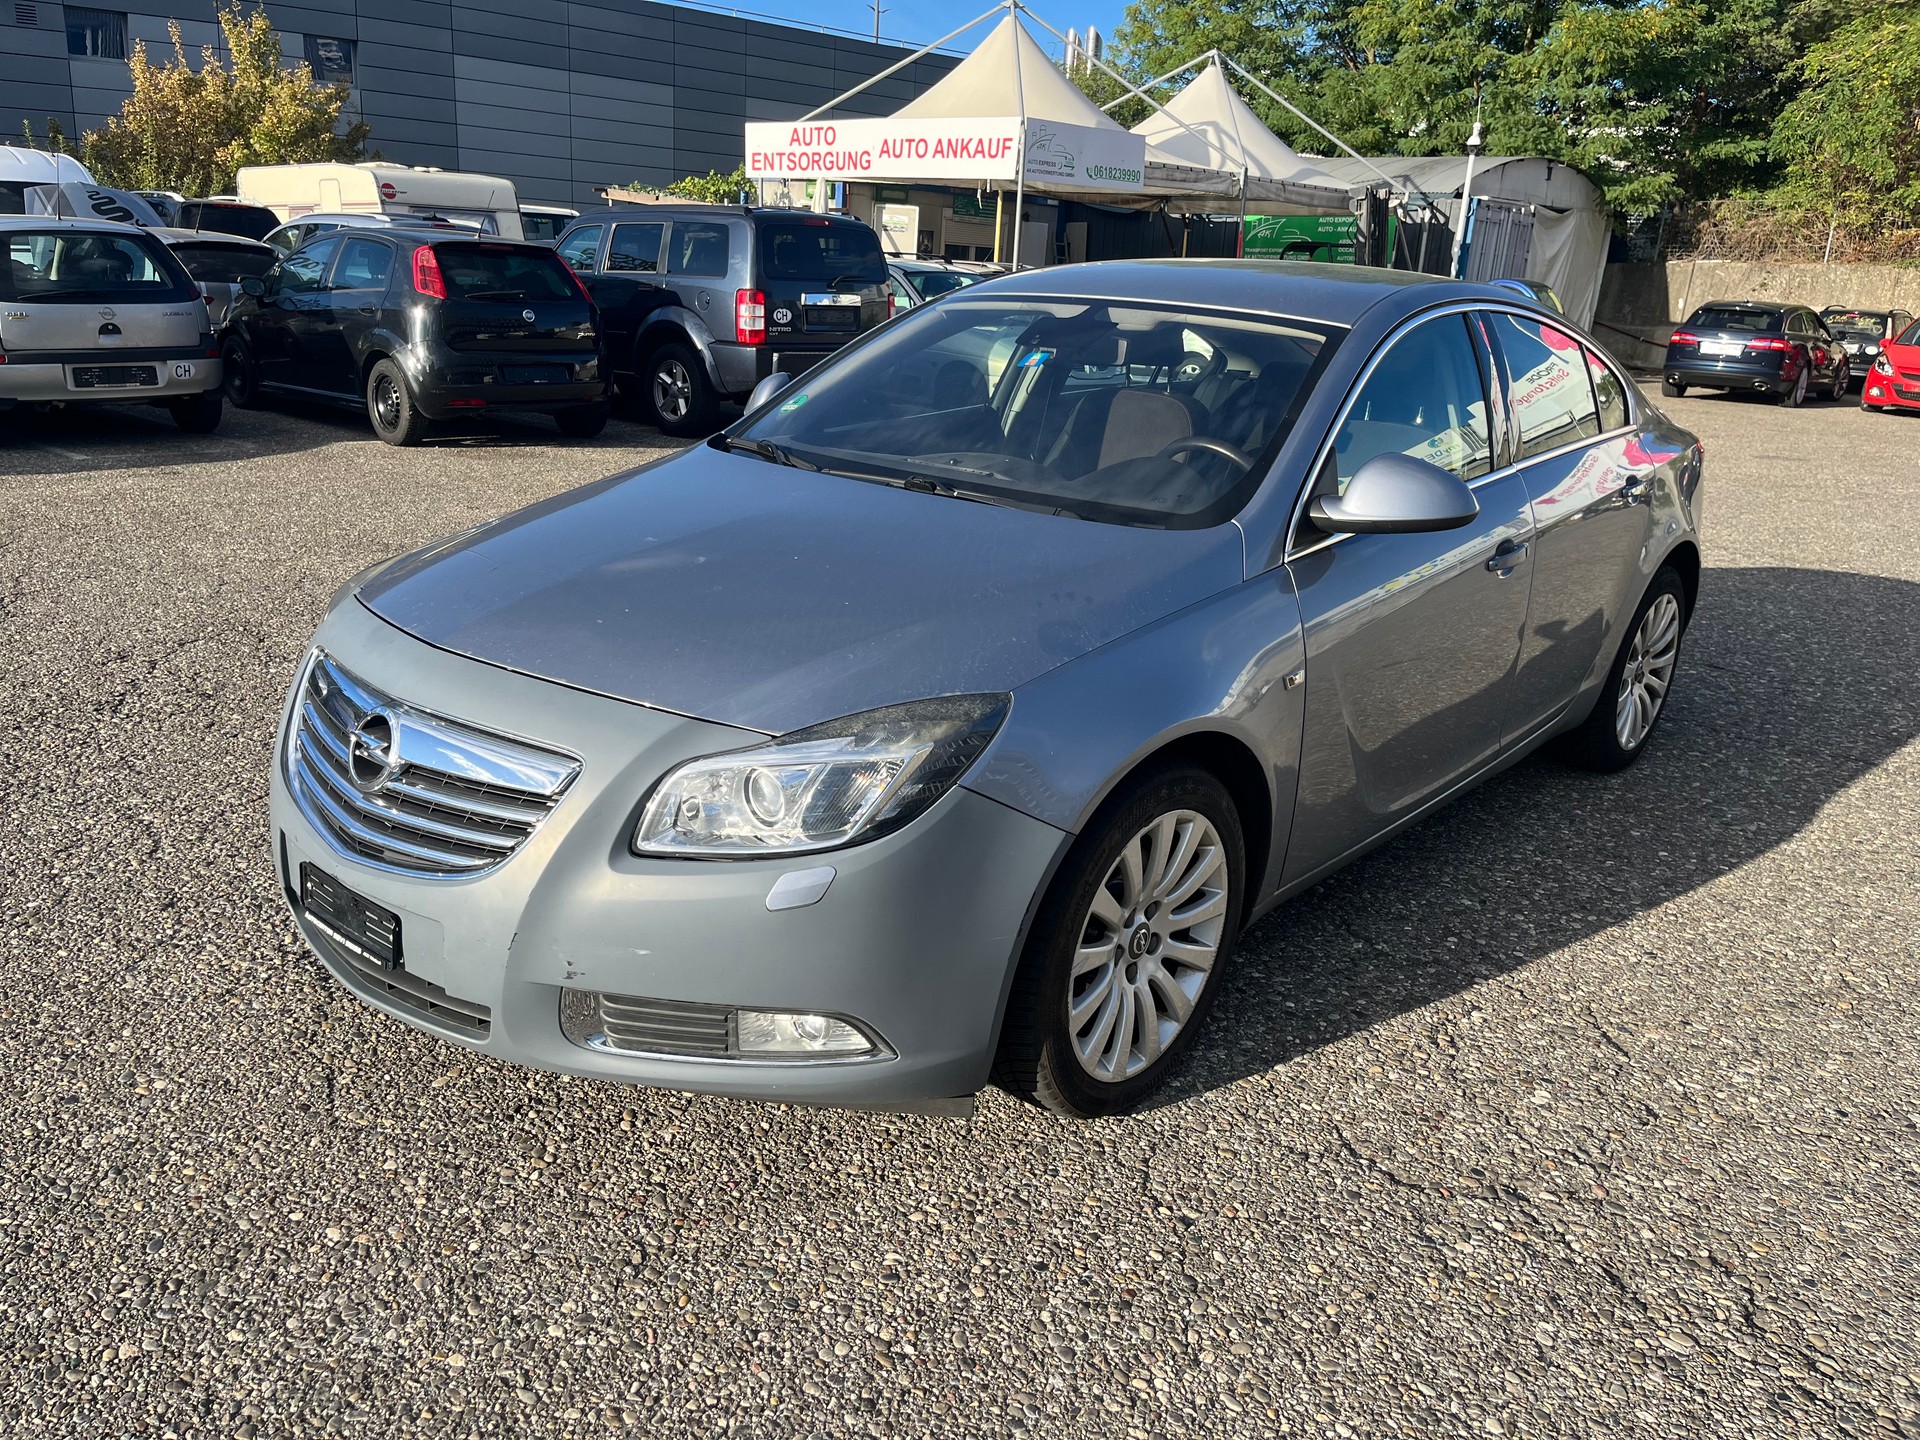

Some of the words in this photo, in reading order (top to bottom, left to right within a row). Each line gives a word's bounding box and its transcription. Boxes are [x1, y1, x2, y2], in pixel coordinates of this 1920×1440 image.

[789, 126, 836, 147] AUTO
[878, 138, 929, 159] AUTO
[932, 137, 1014, 160] ANKAUF
[751, 150, 872, 172] ENTSORGUNG
[1038, 159, 1057, 168] EXPRESS
[1093, 164, 1141, 182] 0618239990
[1257, 229, 1272, 239] AK
[775, 310, 788, 321] CH
[175, 364, 191, 378] CH
